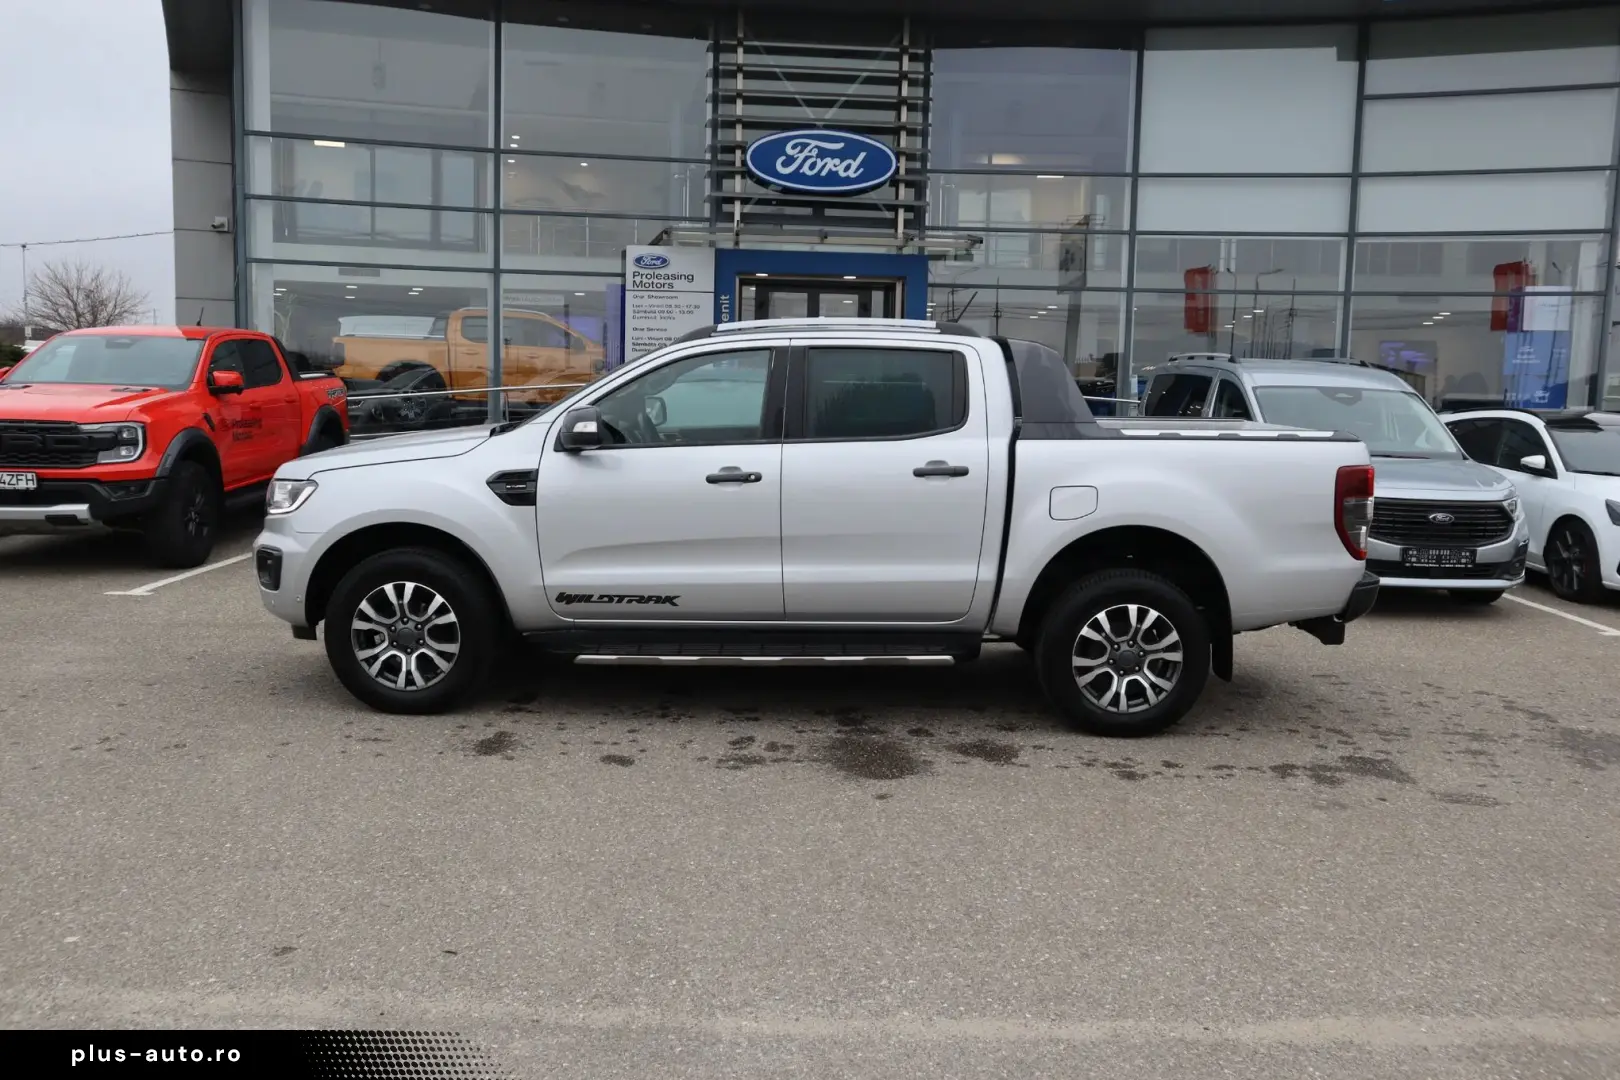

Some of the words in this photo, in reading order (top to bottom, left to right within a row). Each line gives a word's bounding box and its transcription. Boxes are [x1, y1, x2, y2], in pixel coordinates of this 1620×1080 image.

[775, 138, 868, 179] Ford
[640, 255, 663, 265] Ford
[632, 271, 695, 283] Proleasing
[632, 281, 674, 289] Motors
[719, 294, 730, 323] enit
[555, 591, 681, 607] WILDTRAK
